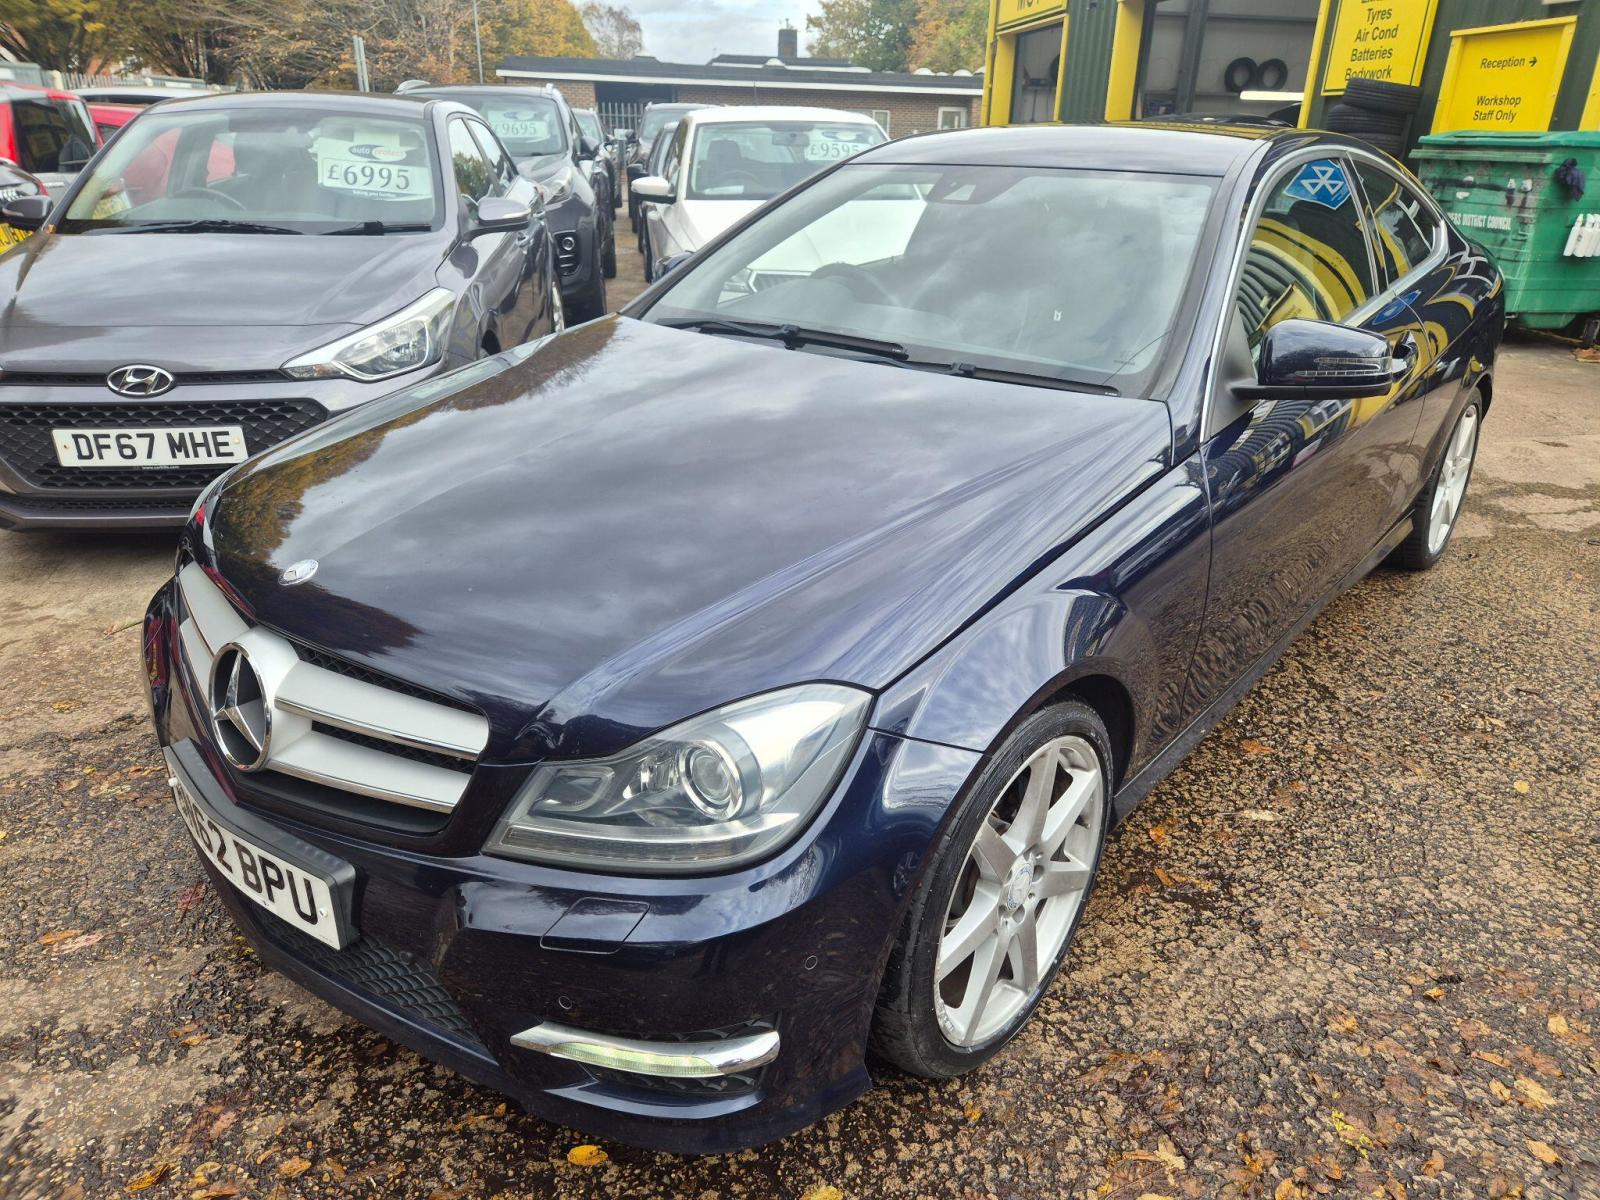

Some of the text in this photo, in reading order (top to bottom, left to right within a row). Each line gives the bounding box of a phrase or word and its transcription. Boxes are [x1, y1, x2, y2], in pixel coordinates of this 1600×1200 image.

[1017, 0, 1040, 11] MO
[1367, 8, 1392, 25] Tyres
[1354, 24, 1400, 42] Air Cond
[1350, 46, 1394, 62] Batteries
[1480, 56, 1526, 70] Reception
[1344, 65, 1393, 81] Bodywork
[1476, 95, 1522, 107] Workshop
[1473, 109, 1517, 123] Staff Only
[351, 146, 371, 155] auto
[327, 163, 410, 190] £6995
[71, 431, 235, 460] DF67 MHE
[233, 839, 319, 926] BPU
